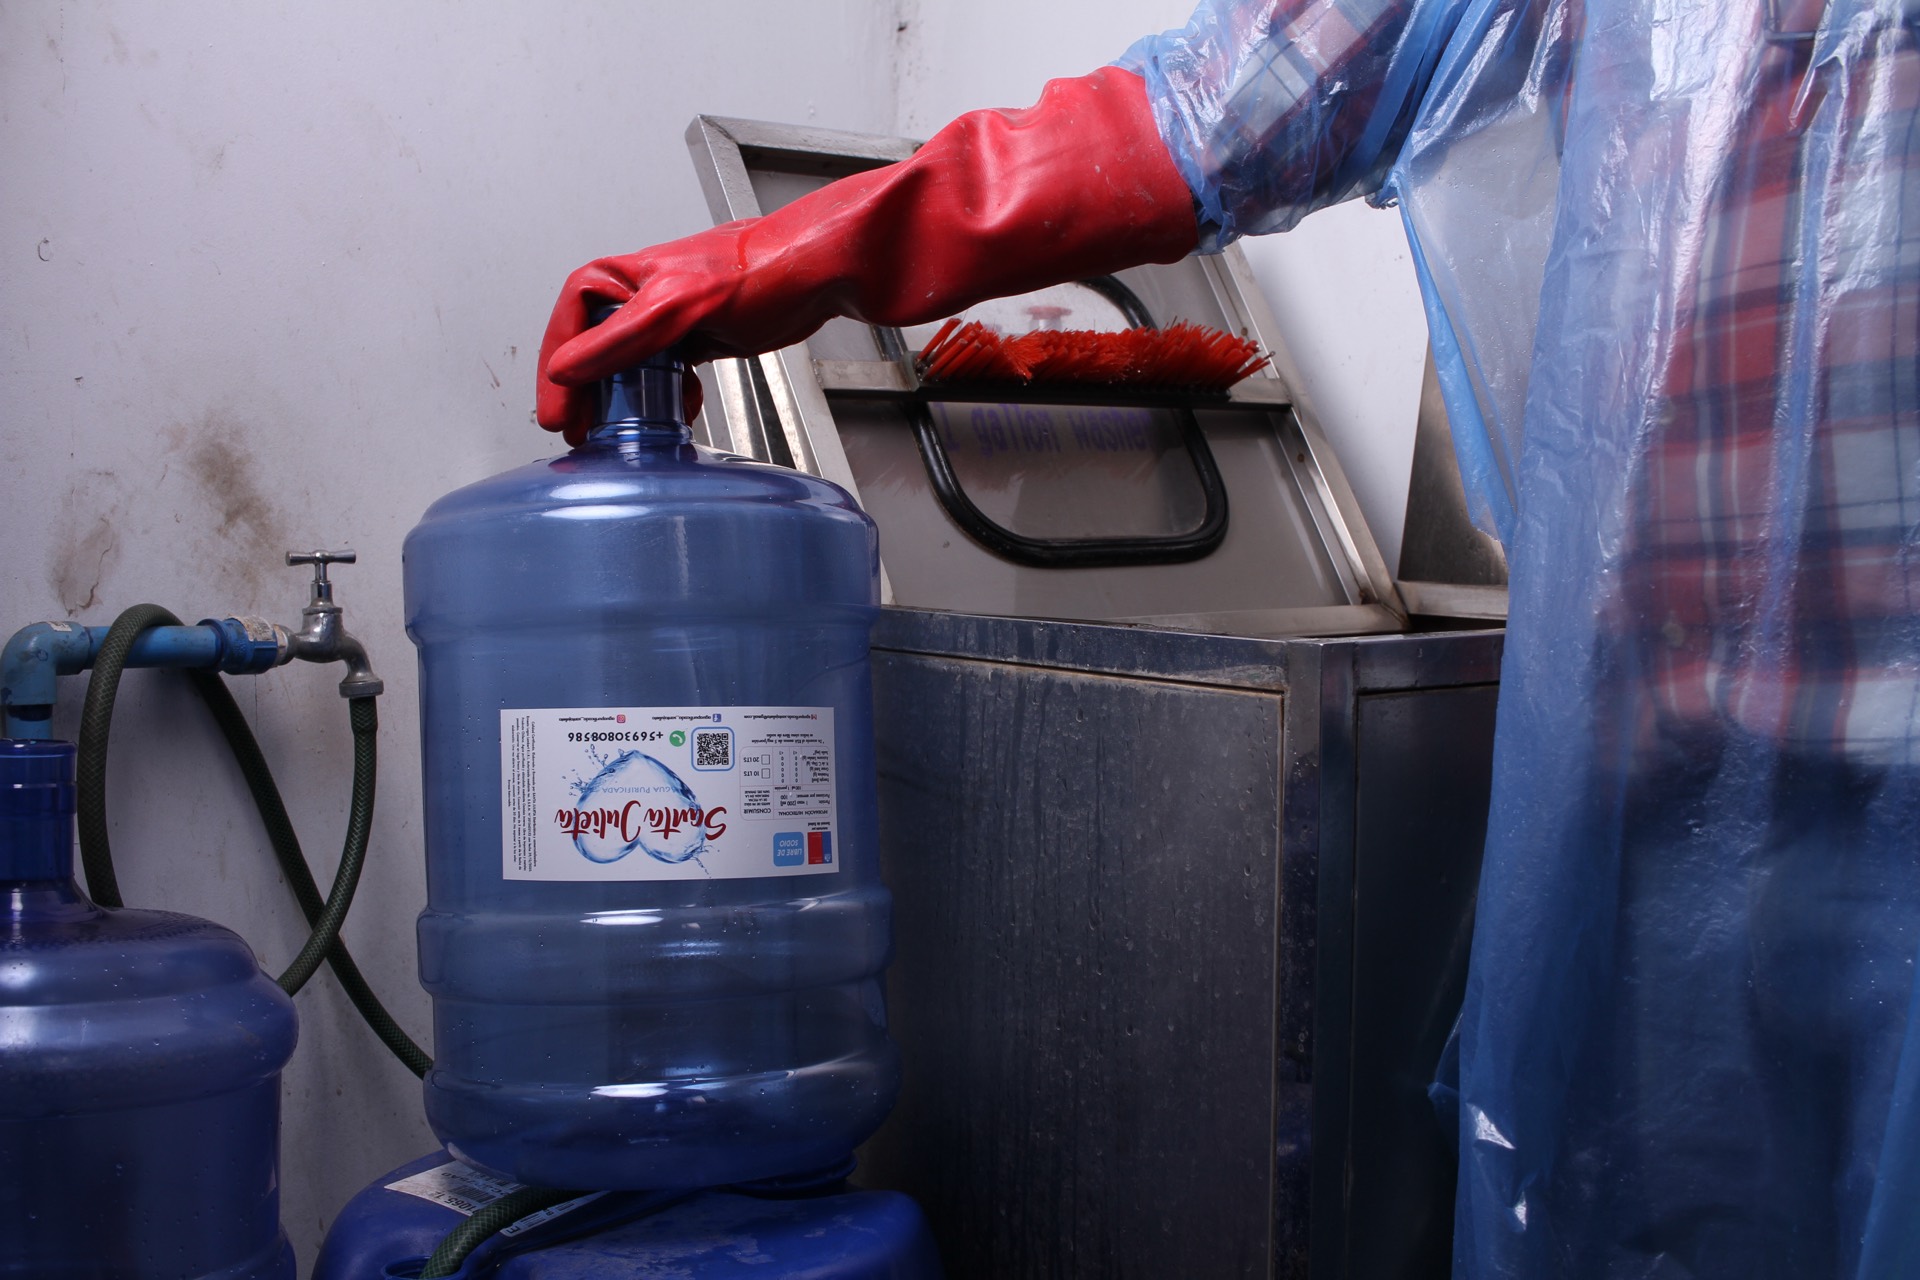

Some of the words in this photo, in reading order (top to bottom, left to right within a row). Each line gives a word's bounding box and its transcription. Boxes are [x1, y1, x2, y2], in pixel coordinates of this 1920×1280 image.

[971, 404, 1061, 459] gallon
[568, 731, 664, 742] +56930808586
[554, 801, 641, 843] Julieta
[644, 806, 727, 841] Santa
